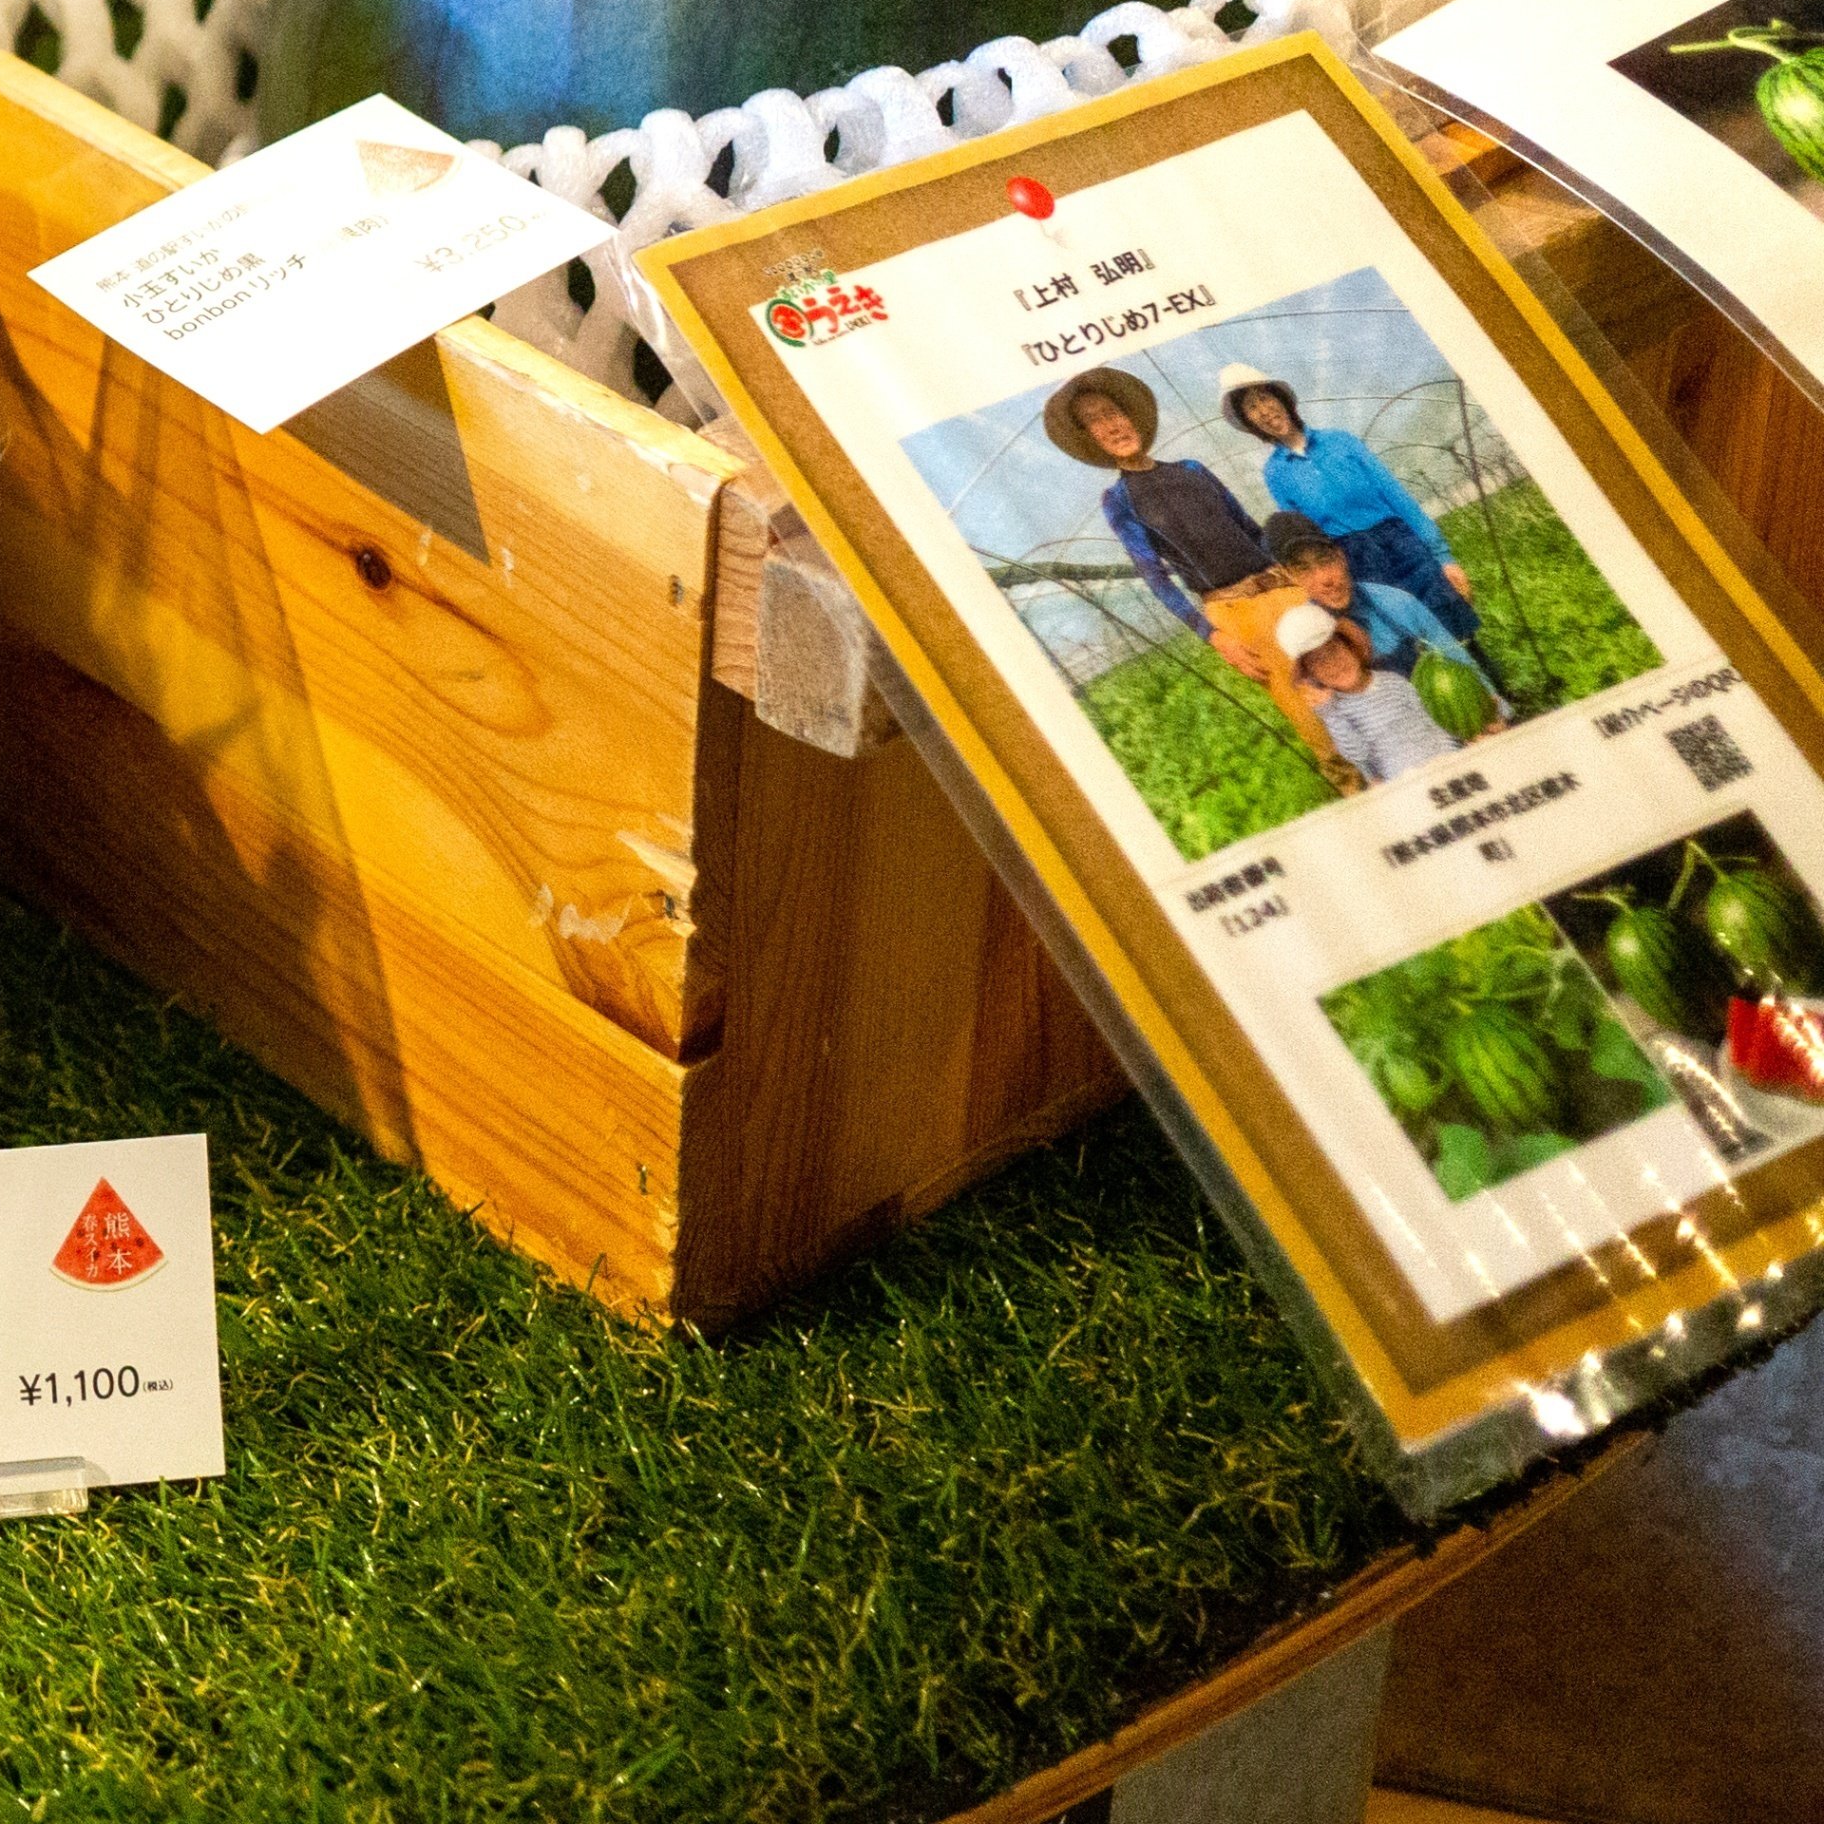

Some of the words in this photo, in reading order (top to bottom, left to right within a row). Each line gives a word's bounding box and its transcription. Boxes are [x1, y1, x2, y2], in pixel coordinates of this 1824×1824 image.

[122, 247, 221, 310] 小玉すいか
[141, 252, 267, 325] ひとりじめ黒
[82, 1214, 99, 1278] 春スイカ
[104, 1212, 132, 1275] 熊本
[18, 1365, 140, 1407] ¥1,100
